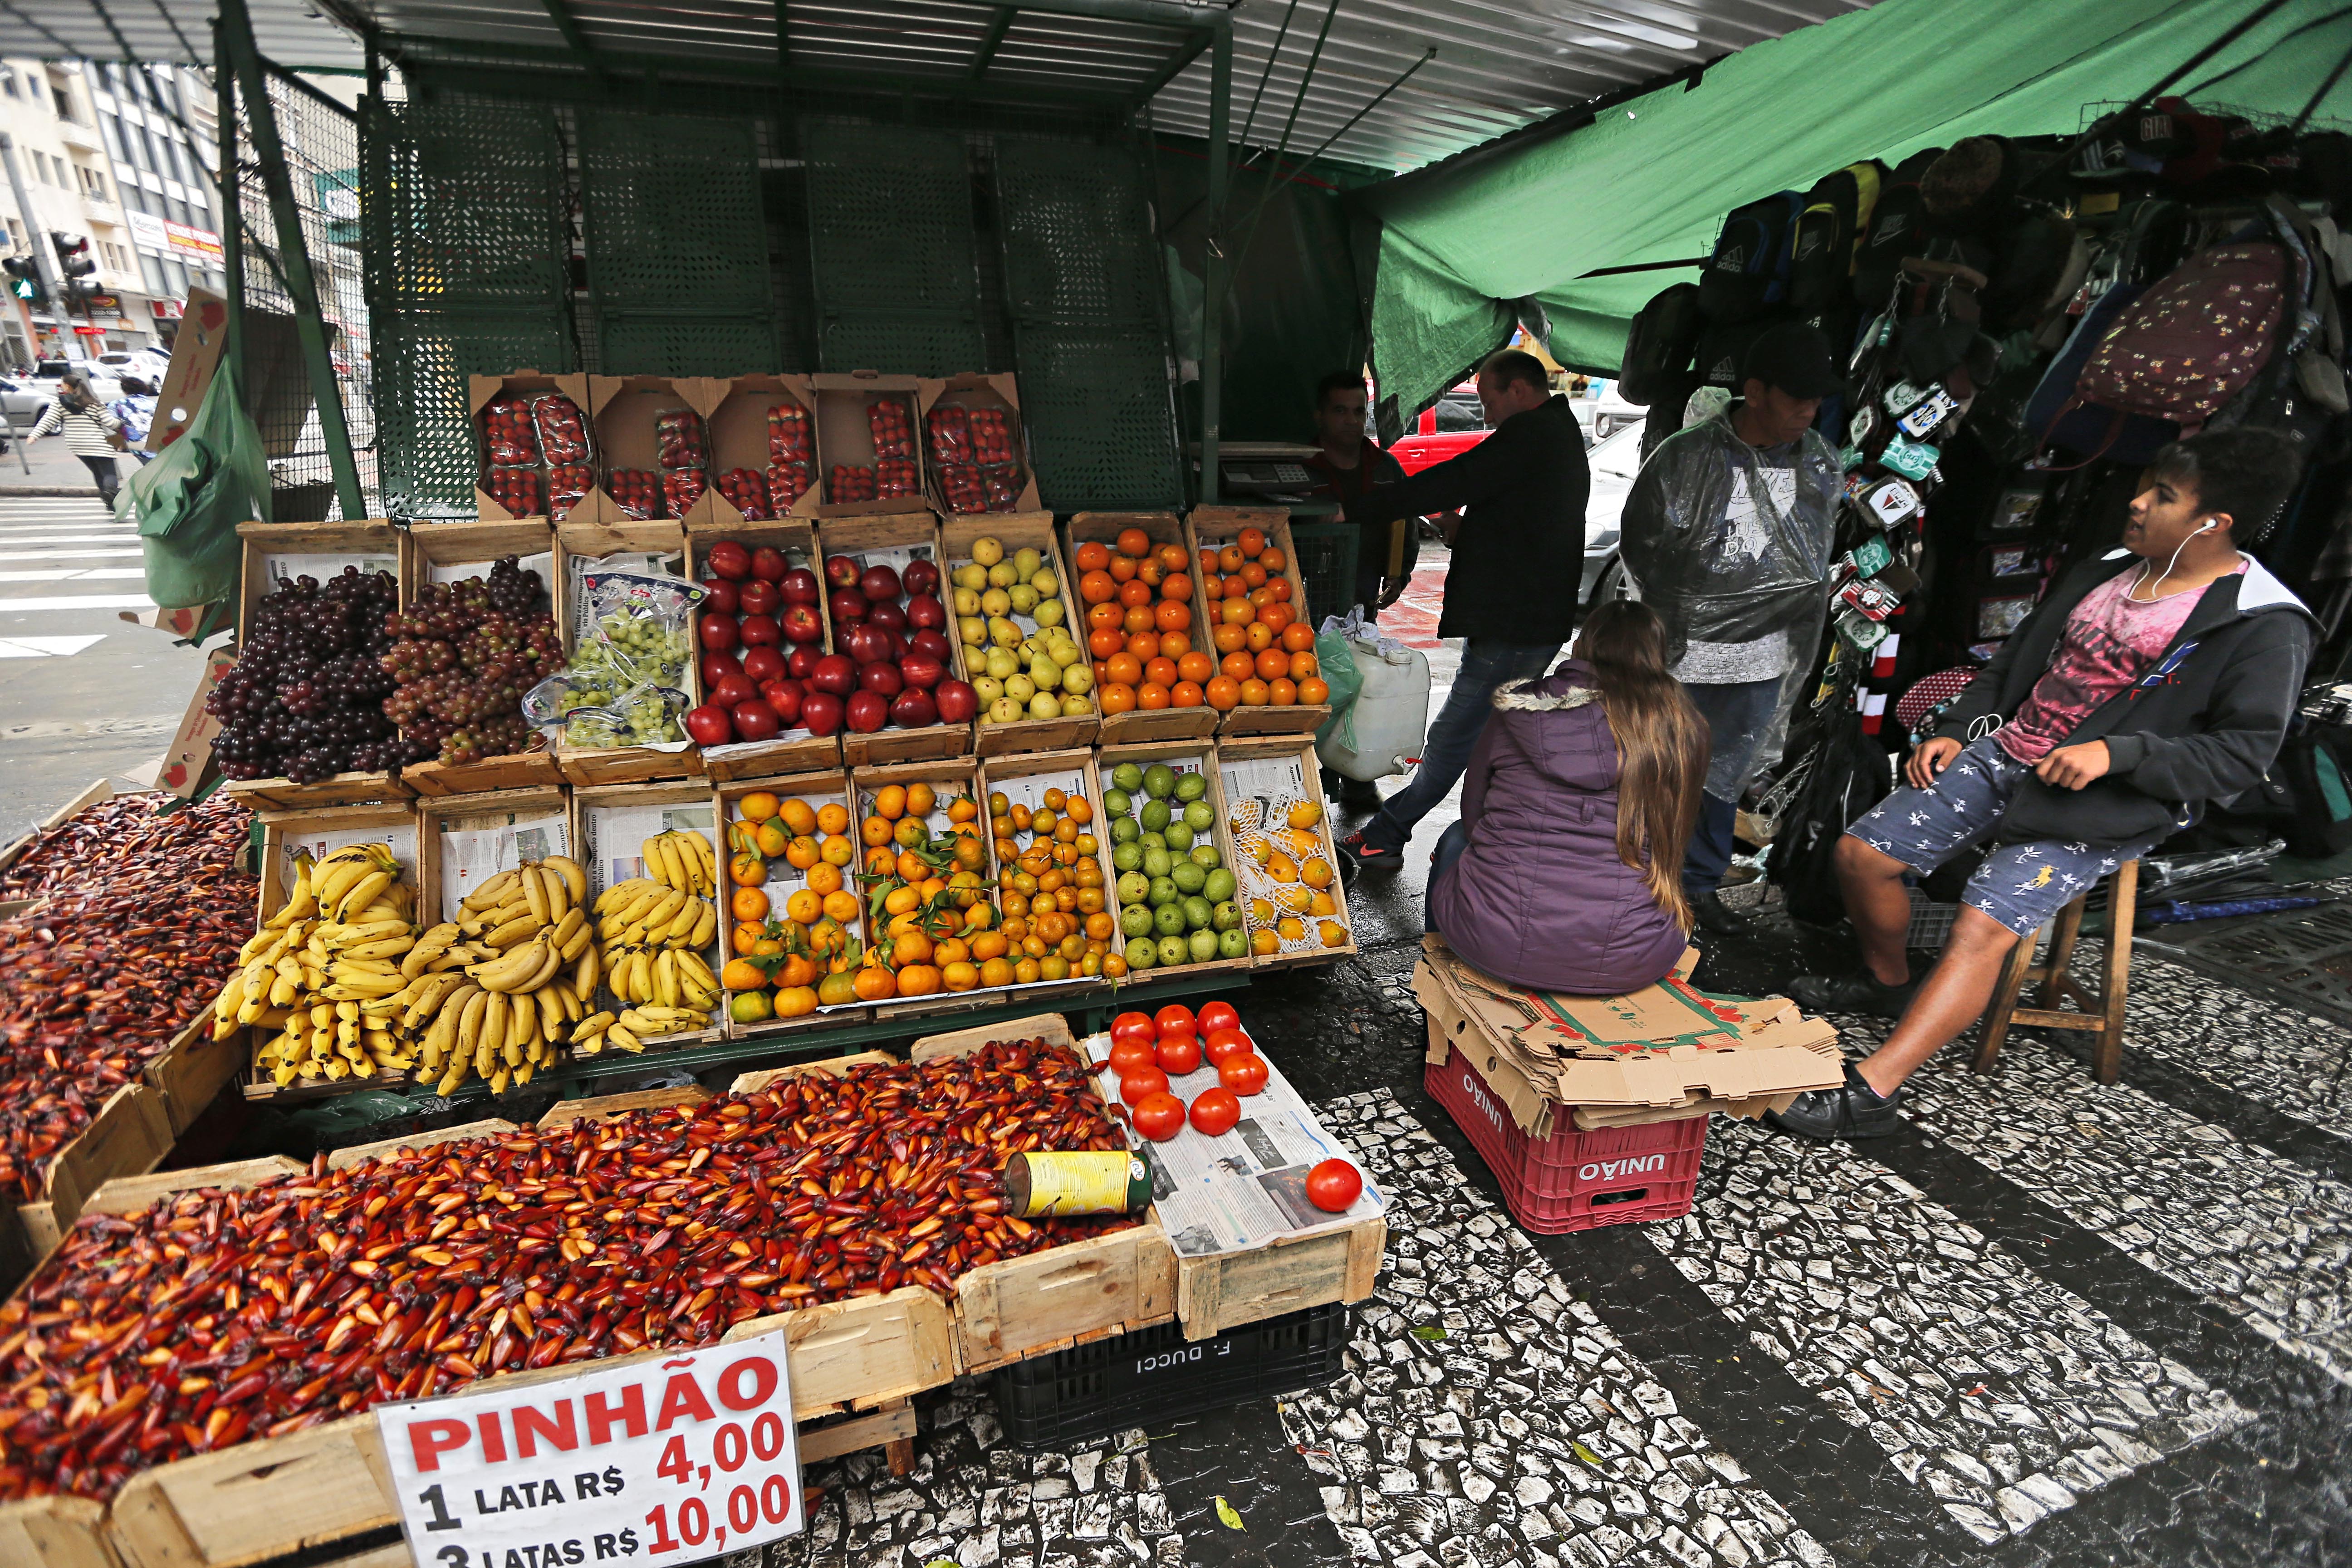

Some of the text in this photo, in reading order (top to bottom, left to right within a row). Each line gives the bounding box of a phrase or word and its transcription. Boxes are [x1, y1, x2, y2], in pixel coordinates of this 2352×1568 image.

[1709, 372, 1736, 382] adidas
[1730, 470, 1790, 499] NKE
[1724, 519, 1764, 539] JUS
[1723, 537, 1758, 557] DO
[578, 557, 588, 573] dentr
[1462, 1073, 1504, 1133] UNIÃO
[1578, 1153, 1666, 1181] UNIÃO
[1137, 1340, 1231, 1374] F. DUCCI
[407, 1356, 779, 1473] PINHÃO
[418, 1411, 785, 1532] 1 LATA R$ 4,00
[482, 1538, 584, 1568] LATAS
[594, 1527, 639, 1560] R$
[644, 1473, 791, 1556] 10,00
